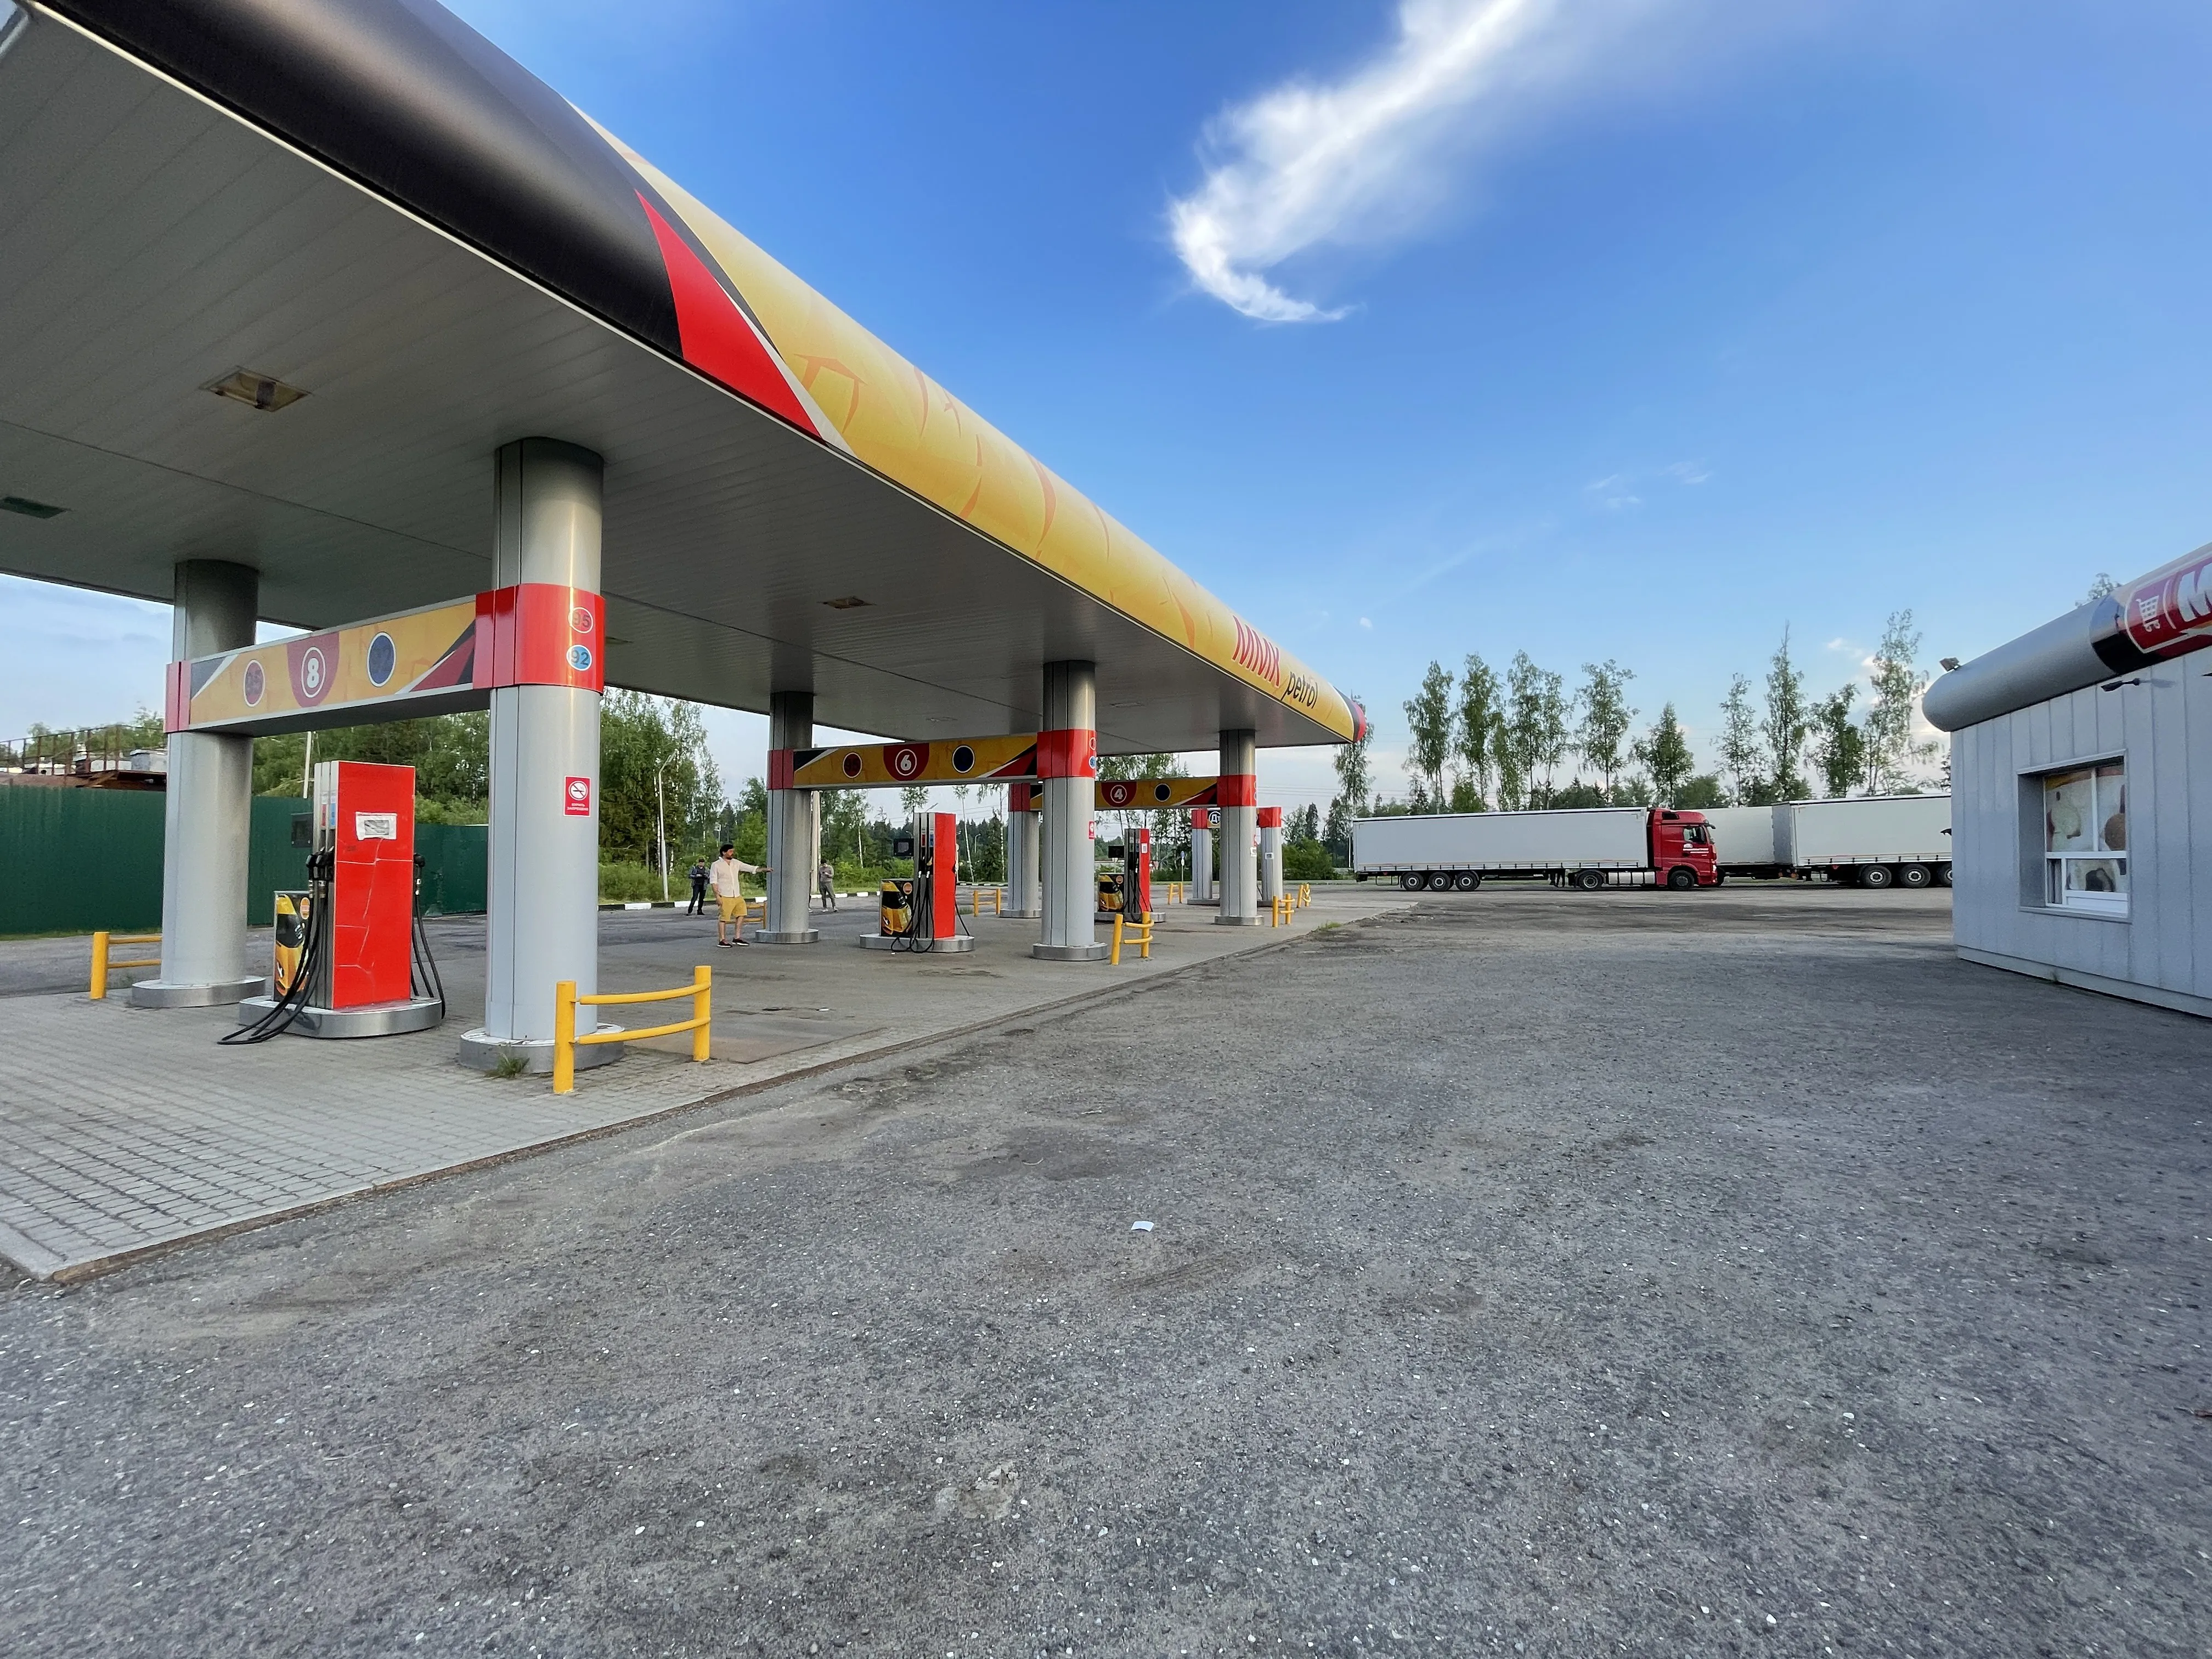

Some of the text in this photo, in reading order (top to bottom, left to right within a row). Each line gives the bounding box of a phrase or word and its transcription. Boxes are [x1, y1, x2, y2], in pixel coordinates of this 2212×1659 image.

[572, 611, 591, 628] 95
[571, 649, 589, 665] 92
[307, 658, 319, 688] 8
[1280, 671, 1318, 709] petrol
[900, 754, 911, 771] 6
[1114, 788, 1123, 799] 4
